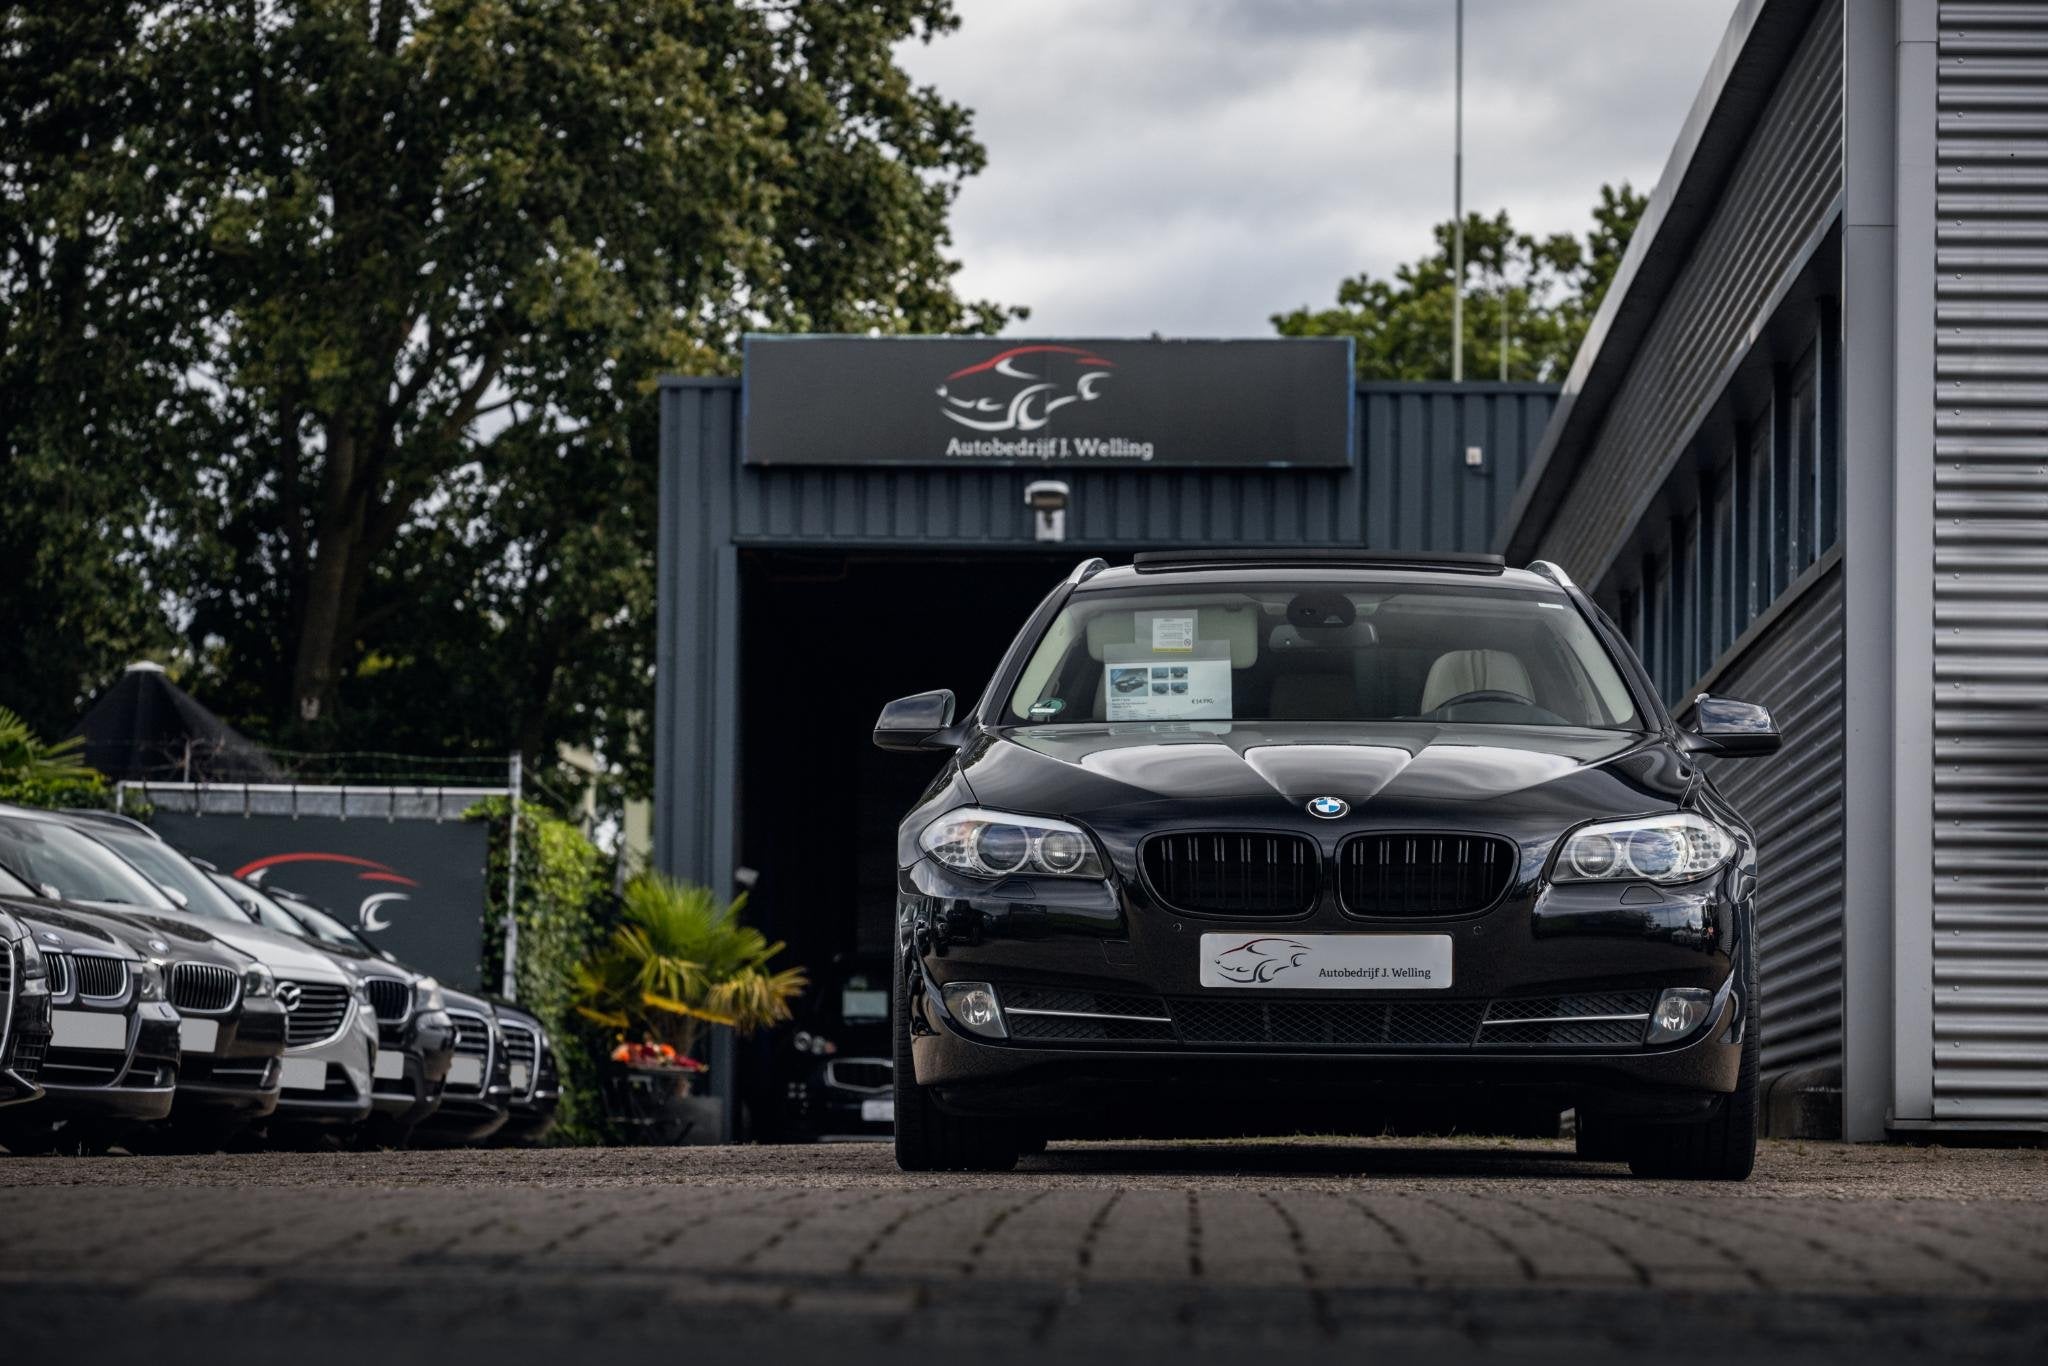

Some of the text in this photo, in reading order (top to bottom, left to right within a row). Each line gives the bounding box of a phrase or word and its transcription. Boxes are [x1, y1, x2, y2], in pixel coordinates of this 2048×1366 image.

[946, 437, 1154, 461] Autobedrijf J. Welling
[1319, 967, 1432, 980] Autobedrijf J. Welling
